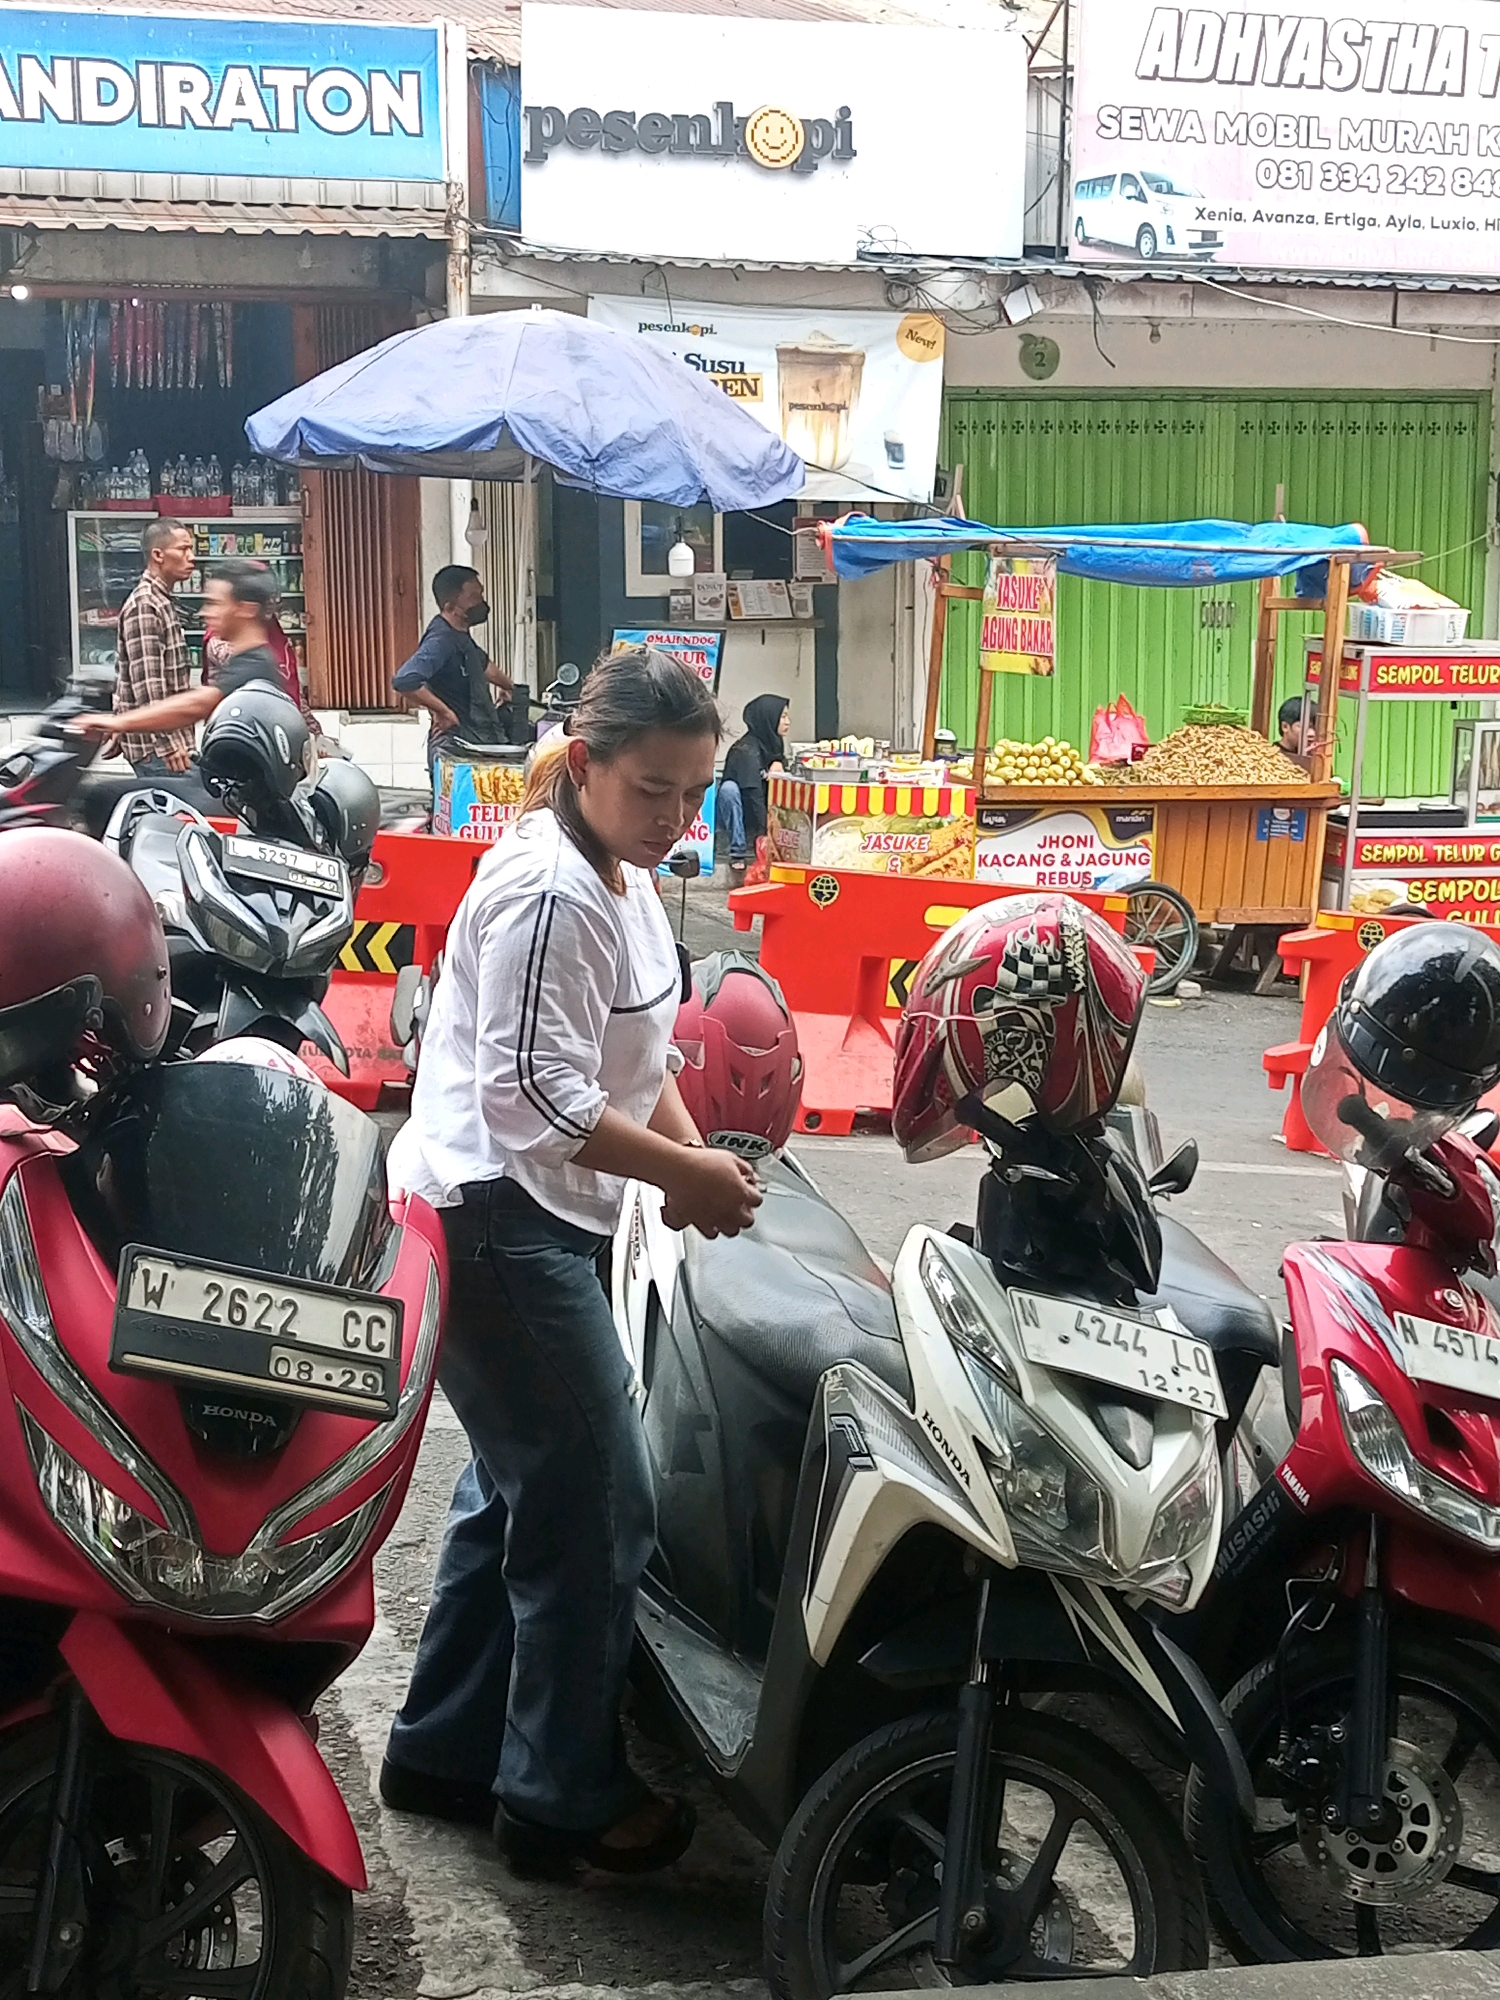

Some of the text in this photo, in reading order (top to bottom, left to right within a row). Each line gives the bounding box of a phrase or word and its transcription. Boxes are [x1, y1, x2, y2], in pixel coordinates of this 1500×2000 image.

[1135, 7, 1468, 96] ADHYASTHA
[1097, 105, 1205, 143] SEWA
[1215, 111, 1330, 149] MOBIL
[1339, 118, 1469, 157] MURAH
[1256, 159, 1313, 190] 081
[1320, 162, 1380, 192] 334
[1386, 165, 1445, 195] 242
[1195, 207, 1246, 223] Xenia,
[1252, 209, 1319, 226] Avanza,
[1324, 212, 1380, 230] Ertiga,
[1385, 214, 1425, 232] Ayla,
[1431, 215, 1479, 231] Luxio,
[905, 328, 936, 350] New!
[1034, 351, 1046, 367] 2
[709, 378, 760, 397] EN
[683, 635, 716, 645] NDOG
[1377, 665, 1444, 685] SEMPOL
[1450, 665, 1500, 685] TELUR
[861, 834, 929, 852] JASUKE
[1037, 835, 1094, 849] JHONI
[1360, 844, 1428, 863] SEMPOL
[1432, 843, 1486, 863] TELUR
[259, 846, 298, 865] 5297
[978, 852, 1150, 868] KACANG & JAGUNG
[1036, 871, 1092, 886] REBUS
[1407, 879, 1500, 903] SEMPOL
[715, 1135, 768, 1152] INK
[141, 1267, 386, 1352] W 2622 CC
[1018, 1296, 1041, 1329] N
[1074, 1310, 1147, 1357] 4244
[1433, 1326, 1498, 1366] 4574
[203, 1404, 277, 1427] HONDA
[921, 1410, 971, 1490] HONDA
[1280, 1463, 1311, 1507] YAMAHA
